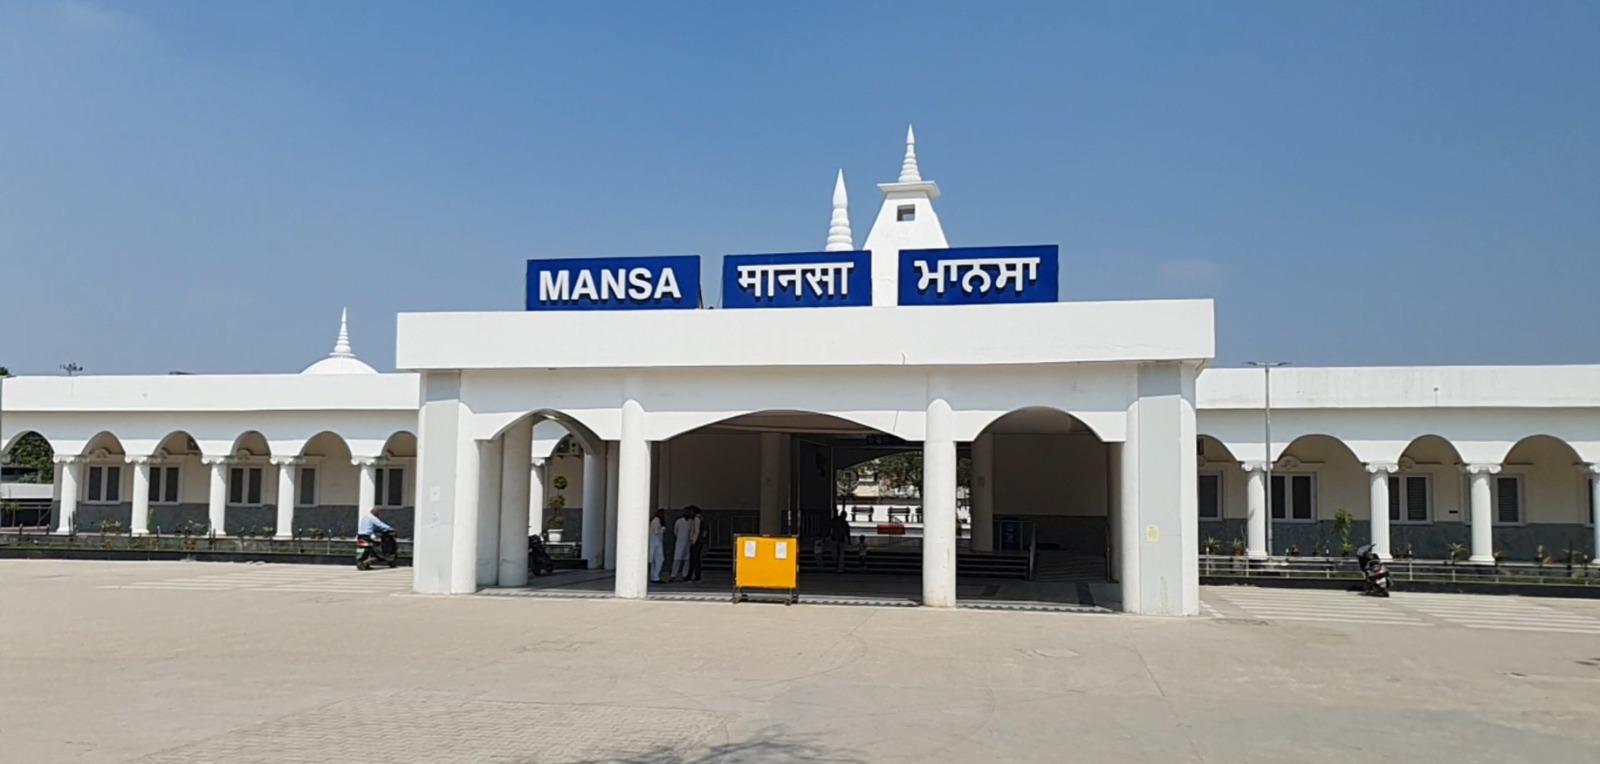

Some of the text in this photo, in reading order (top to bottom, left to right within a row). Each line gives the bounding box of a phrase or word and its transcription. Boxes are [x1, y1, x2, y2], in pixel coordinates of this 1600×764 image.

[538, 267, 682, 301] MANSA
[737, 261, 854, 297] मानसा
[914, 257, 1041, 293] ਮਾਨਸਾ
